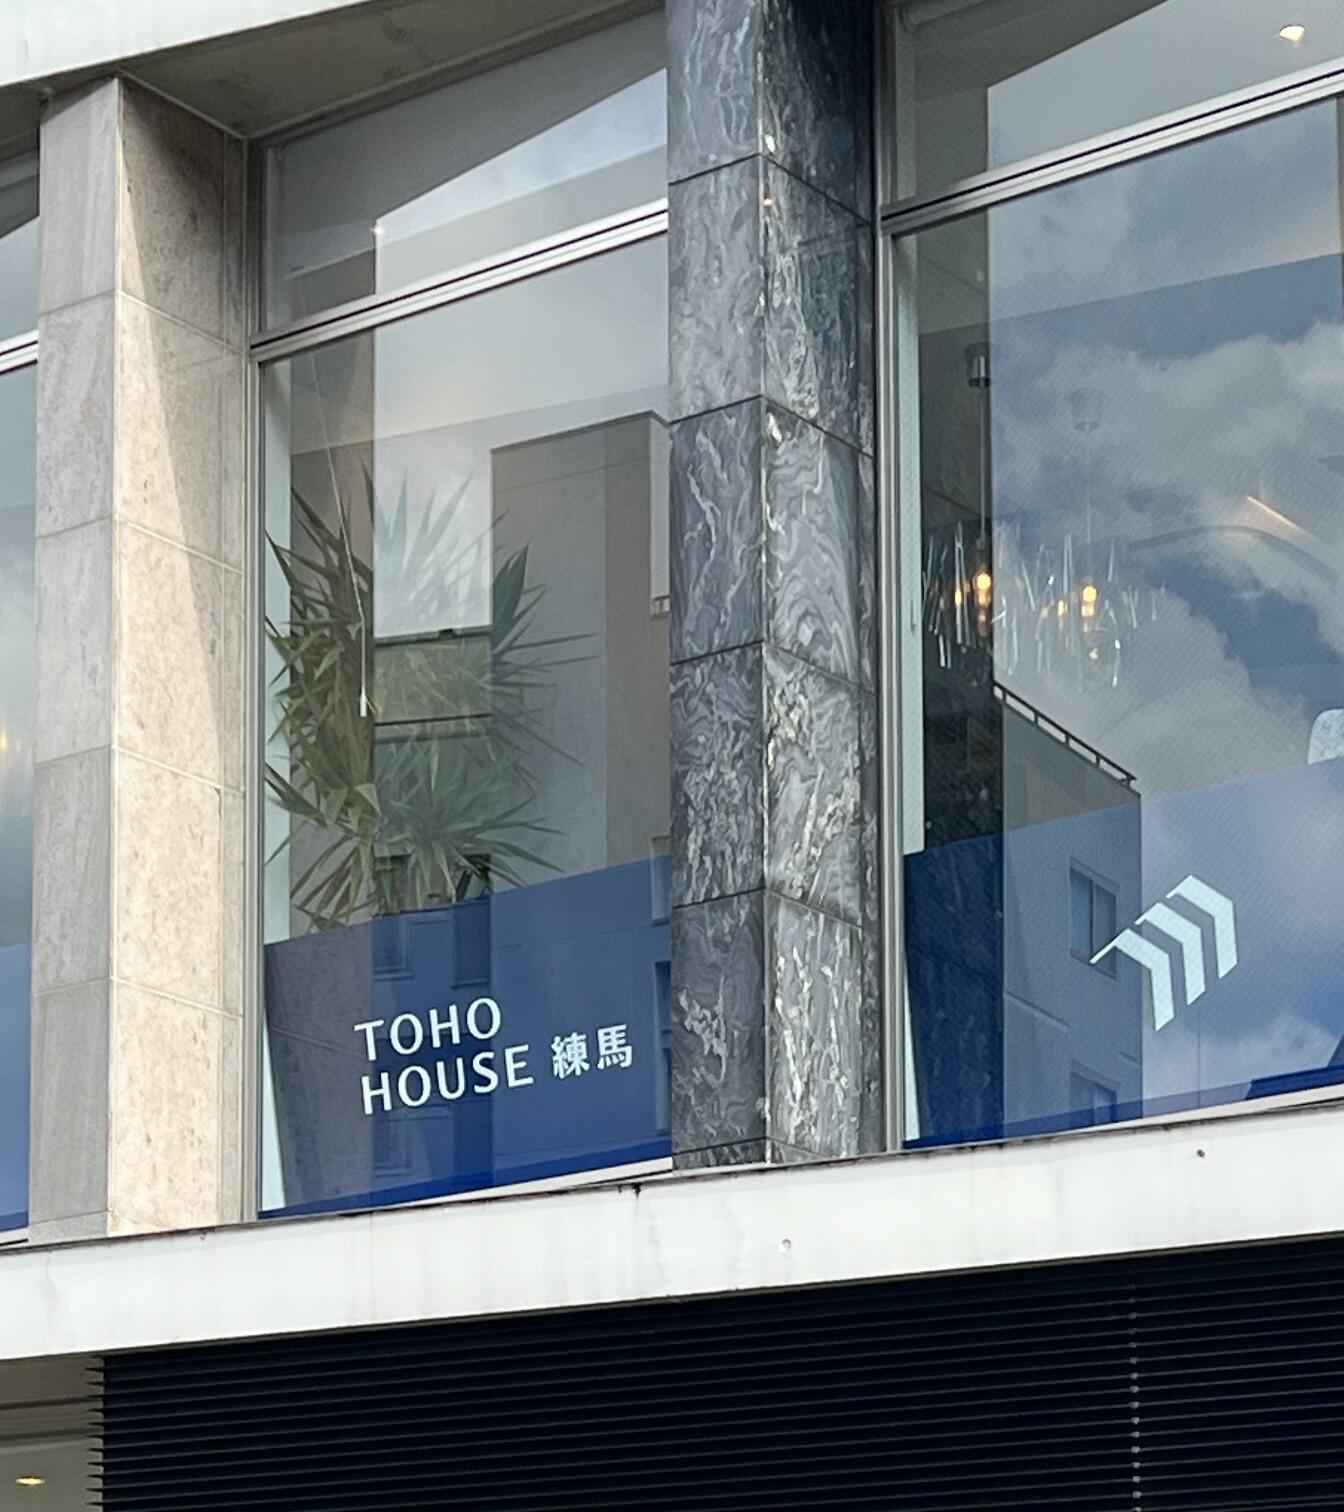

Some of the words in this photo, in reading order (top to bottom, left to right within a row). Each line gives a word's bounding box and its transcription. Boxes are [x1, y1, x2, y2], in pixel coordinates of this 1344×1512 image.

[354, 998, 501, 1061] TOHO
[361, 1044, 533, 1115] HOUSE
[551, 1024, 633, 1080] 練馬
